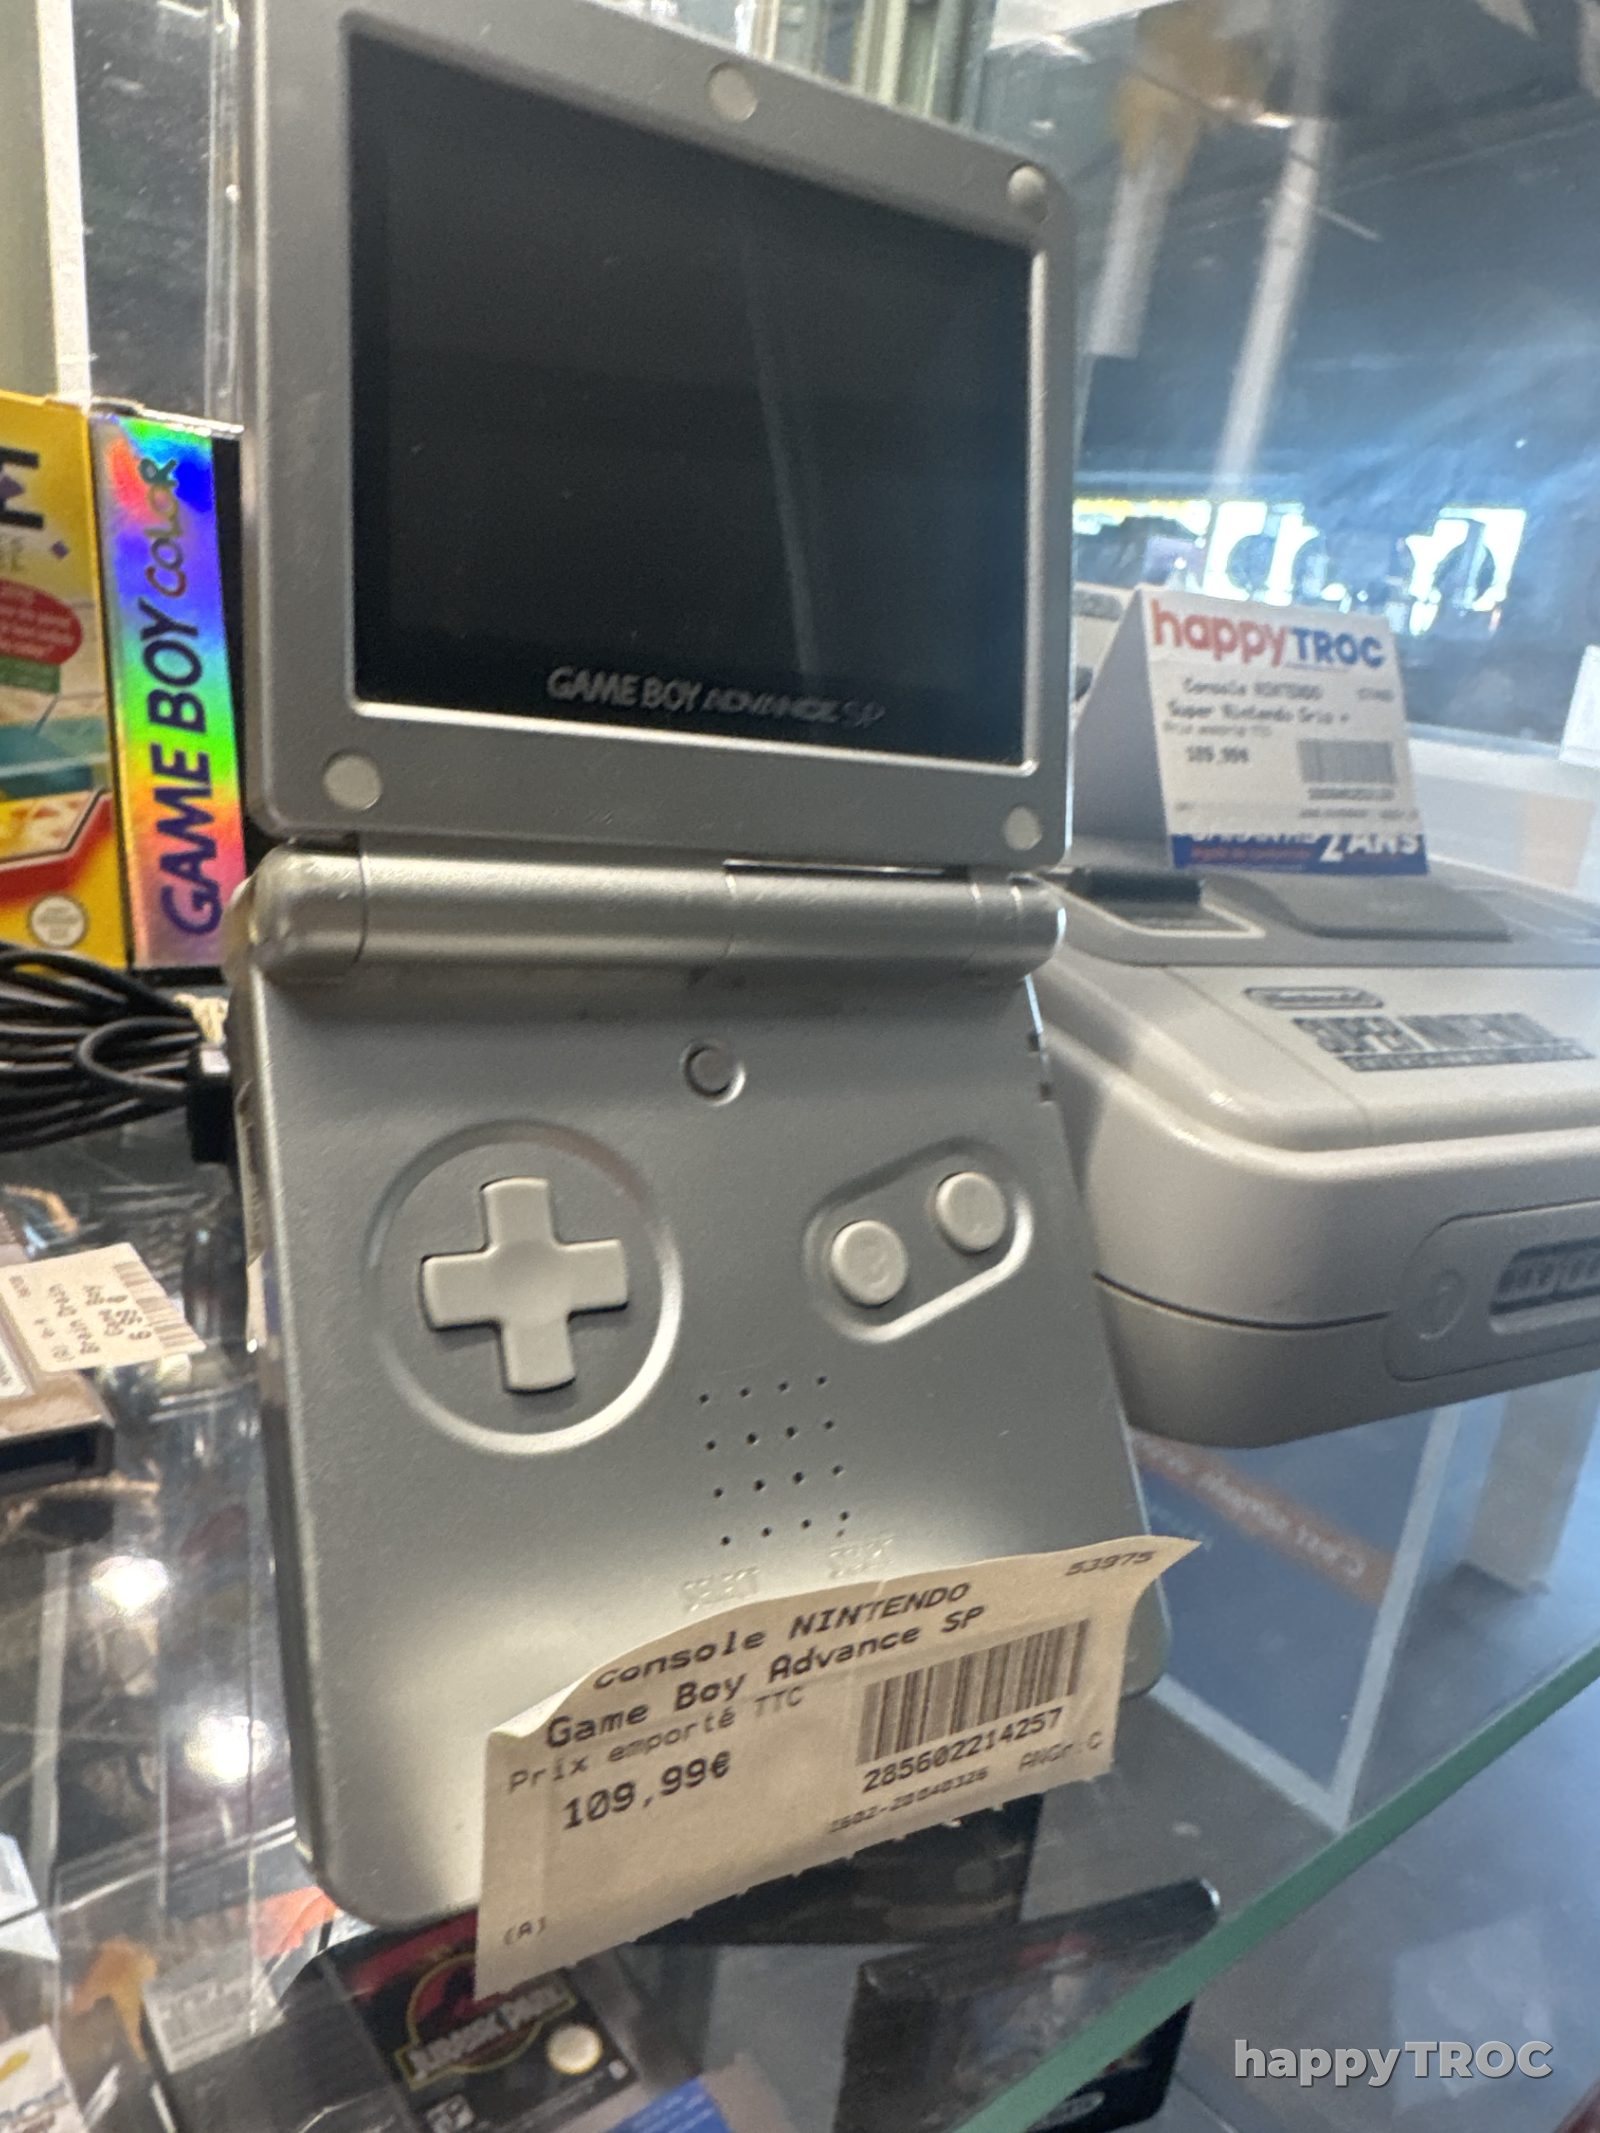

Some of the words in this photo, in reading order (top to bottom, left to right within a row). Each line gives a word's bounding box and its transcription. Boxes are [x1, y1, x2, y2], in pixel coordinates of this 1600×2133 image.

[141, 458, 187, 597] COLOR
[139, 599, 207, 735] BOY
[548, 666, 641, 707] GAME
[640, 676, 701, 713] BOY
[152, 742, 222, 936] GAME
[788, 1581, 970, 1639] NINTENDO
[1065, 1550, 1156, 1576] 53975
[546, 1704, 649, 1748] Game
[673, 1672, 748, 1711] Boy
[767, 1624, 922, 1683] Advance
[940, 1605, 985, 1634] SP
[508, 1755, 589, 1794] Prix
[607, 1706, 736, 1763] emporté
[754, 1686, 805, 1718] TTC
[862, 1706, 1064, 1793] 285602214257
[563, 1751, 731, 1830] 109,99€
